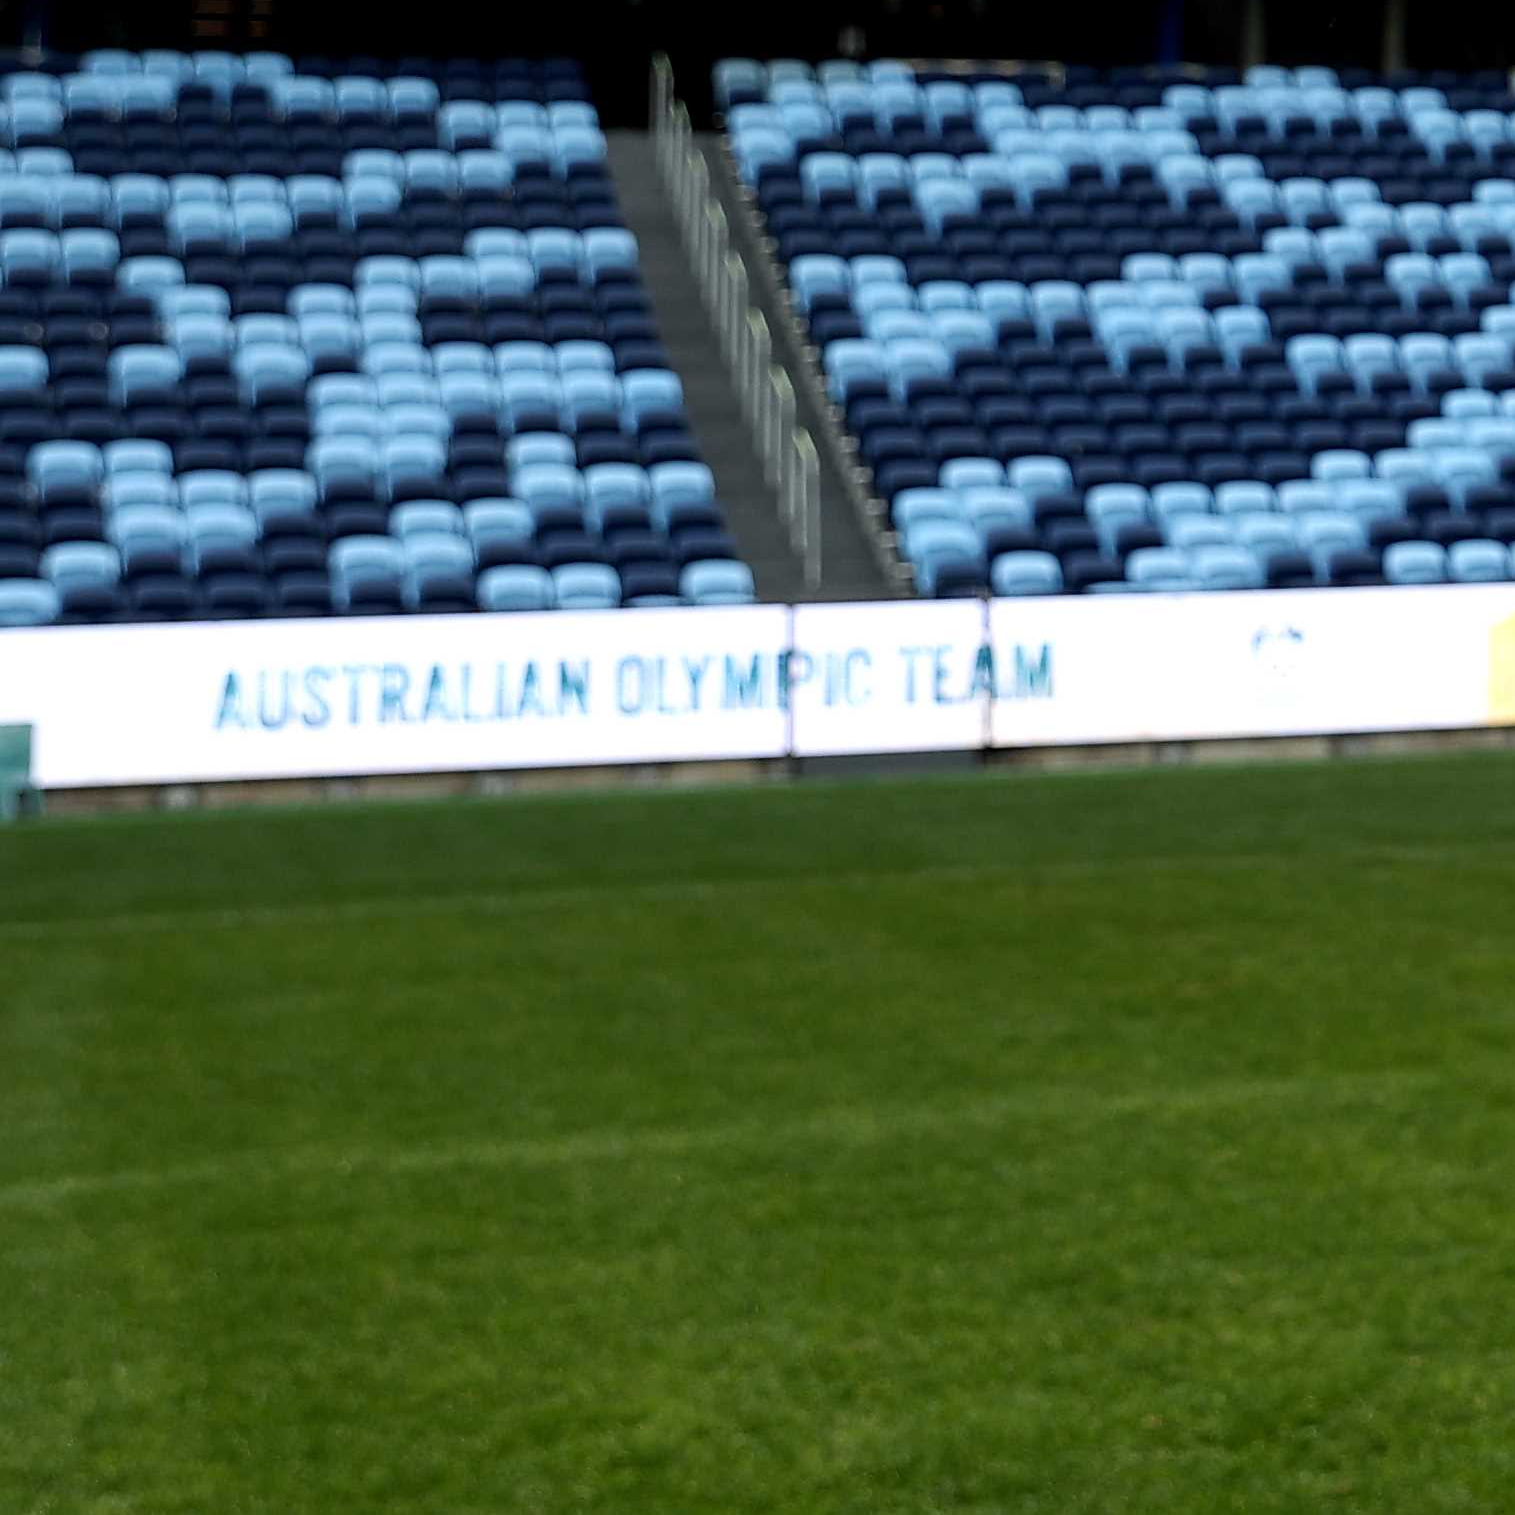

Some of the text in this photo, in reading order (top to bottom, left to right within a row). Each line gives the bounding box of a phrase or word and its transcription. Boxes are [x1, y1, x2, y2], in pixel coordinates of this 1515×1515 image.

[213, 642, 1055, 731] AUSTRALIAN OLYMPIC TEAM
